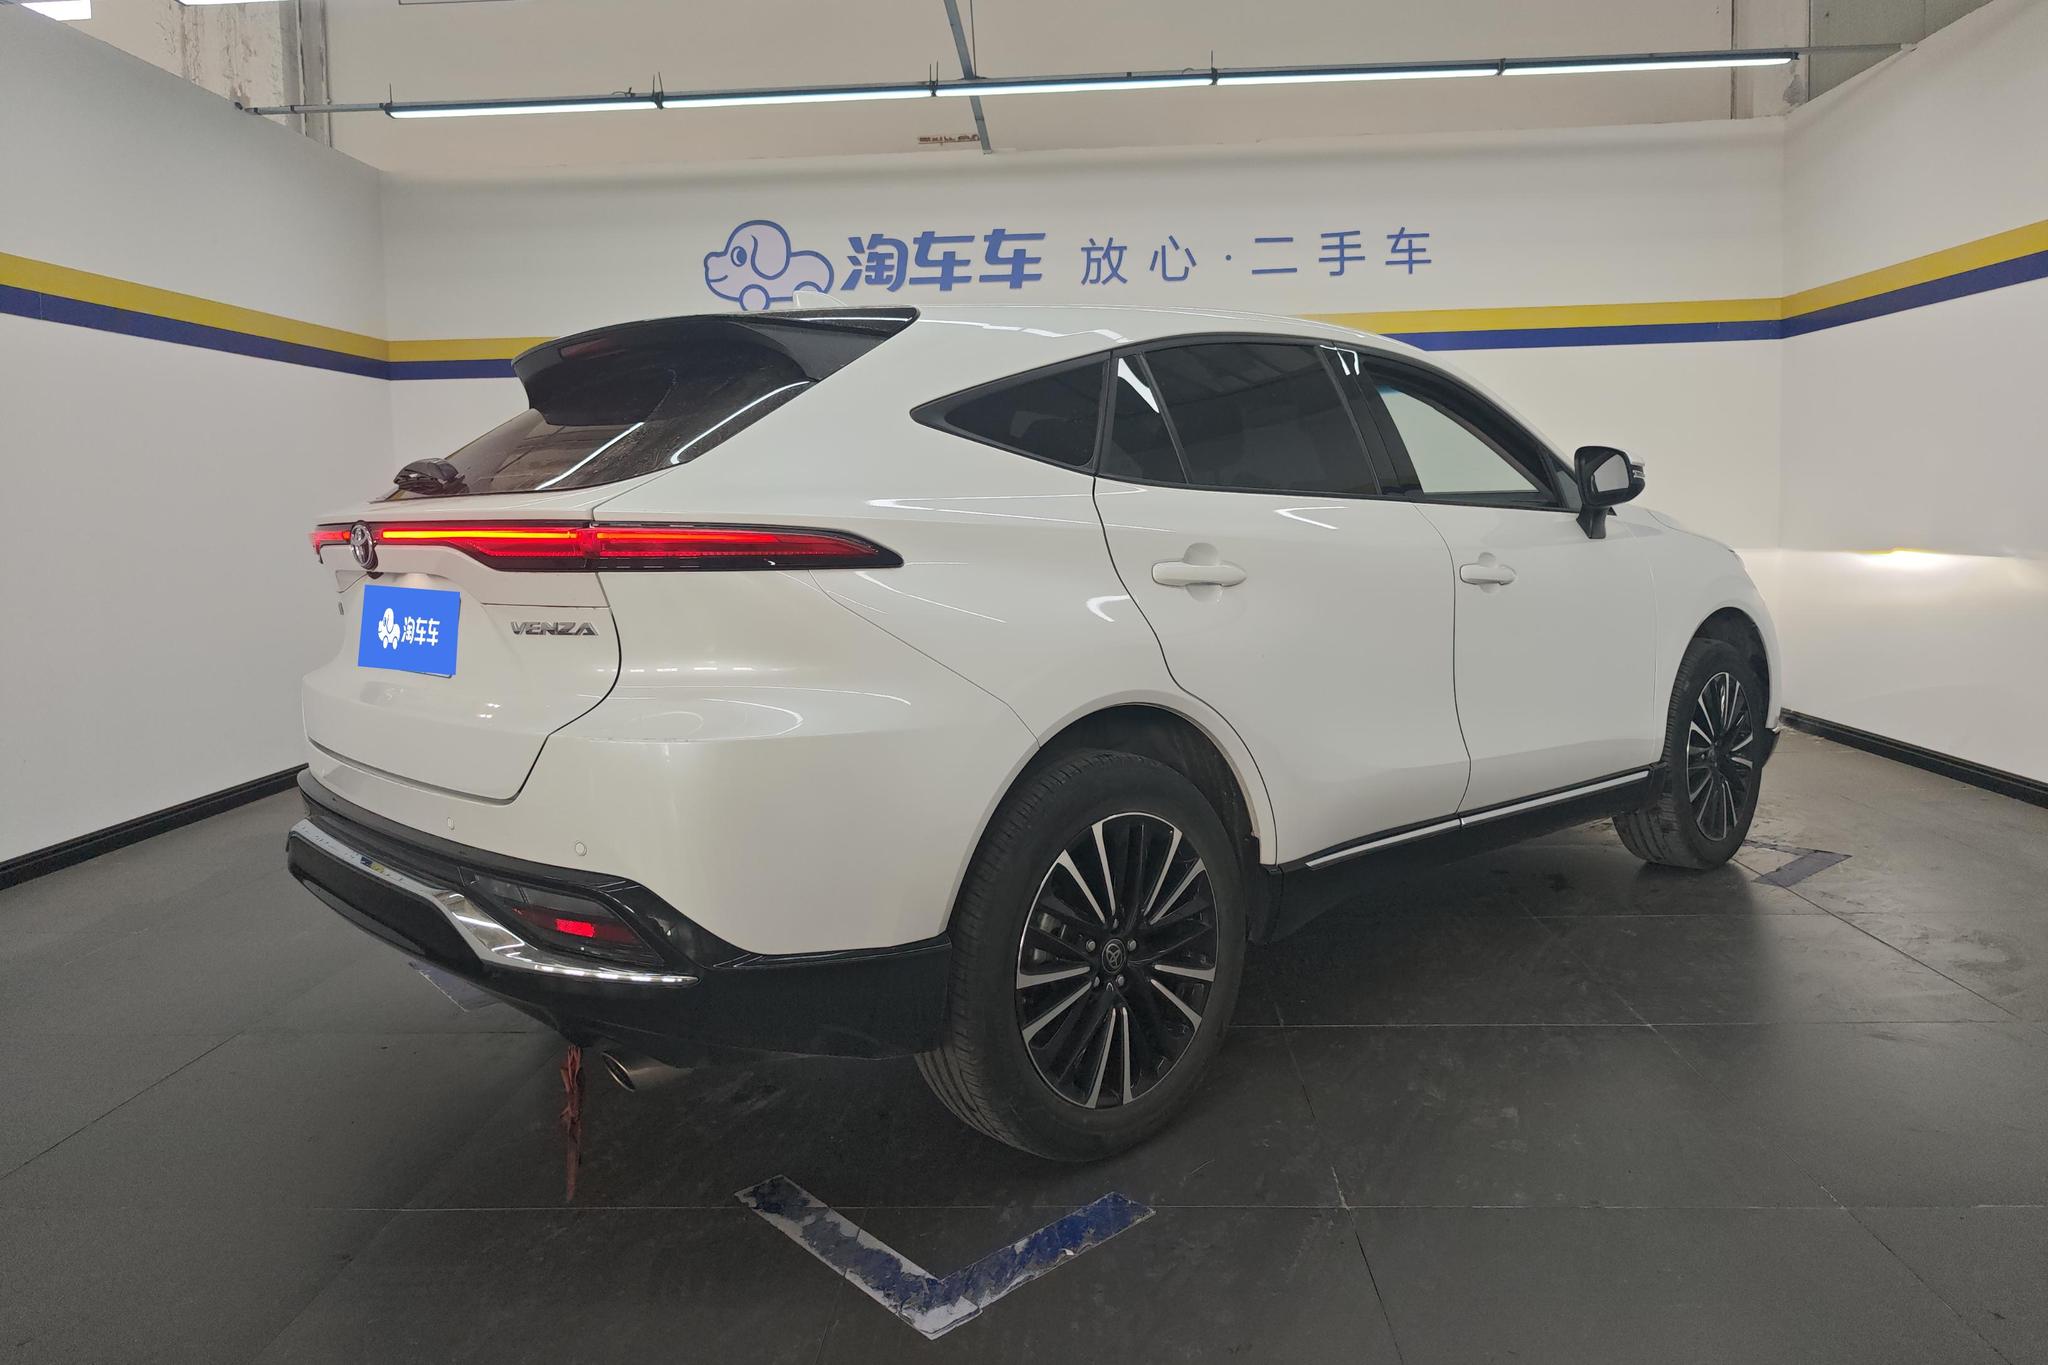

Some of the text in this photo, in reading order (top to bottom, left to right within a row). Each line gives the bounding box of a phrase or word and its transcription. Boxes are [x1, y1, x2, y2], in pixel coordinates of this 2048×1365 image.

[841, 228, 1046, 292] 淘车车
[510, 621, 599, 636] VENZA
